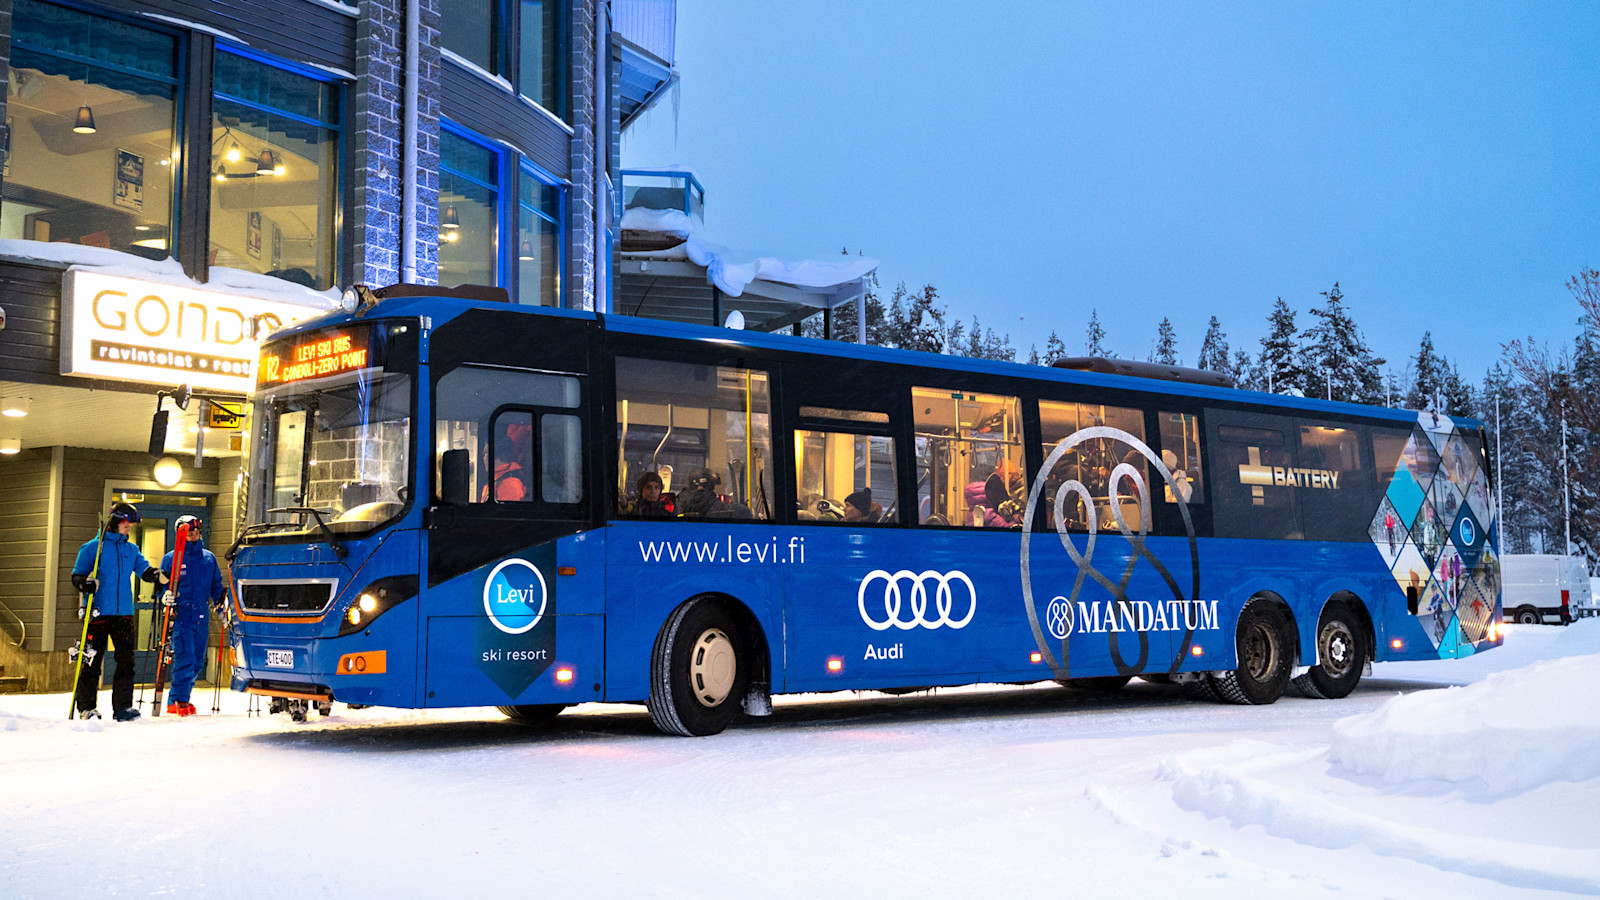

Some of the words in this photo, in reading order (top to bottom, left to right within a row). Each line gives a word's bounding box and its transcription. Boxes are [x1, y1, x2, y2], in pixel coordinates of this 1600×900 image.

[92, 290, 297, 344] GOND
[298, 345, 316, 362] LEVI
[317, 339, 332, 357] SKI
[333, 336, 351, 352] BUS
[266, 355, 280, 382] R2
[283, 358, 340, 382] GONDOLI-ZERO
[341, 350, 367, 370] POINT
[1273, 466, 1338, 489] BATTERY
[638, 535, 806, 564] www.levi.fi
[497, 584, 534, 603] Levi
[1077, 600, 1220, 633] MANDATUM
[268, 652, 292, 665] CTE-400
[482, 649, 502, 661] ski
[507, 649, 547, 661] resort
[864, 644, 903, 660] Audi
